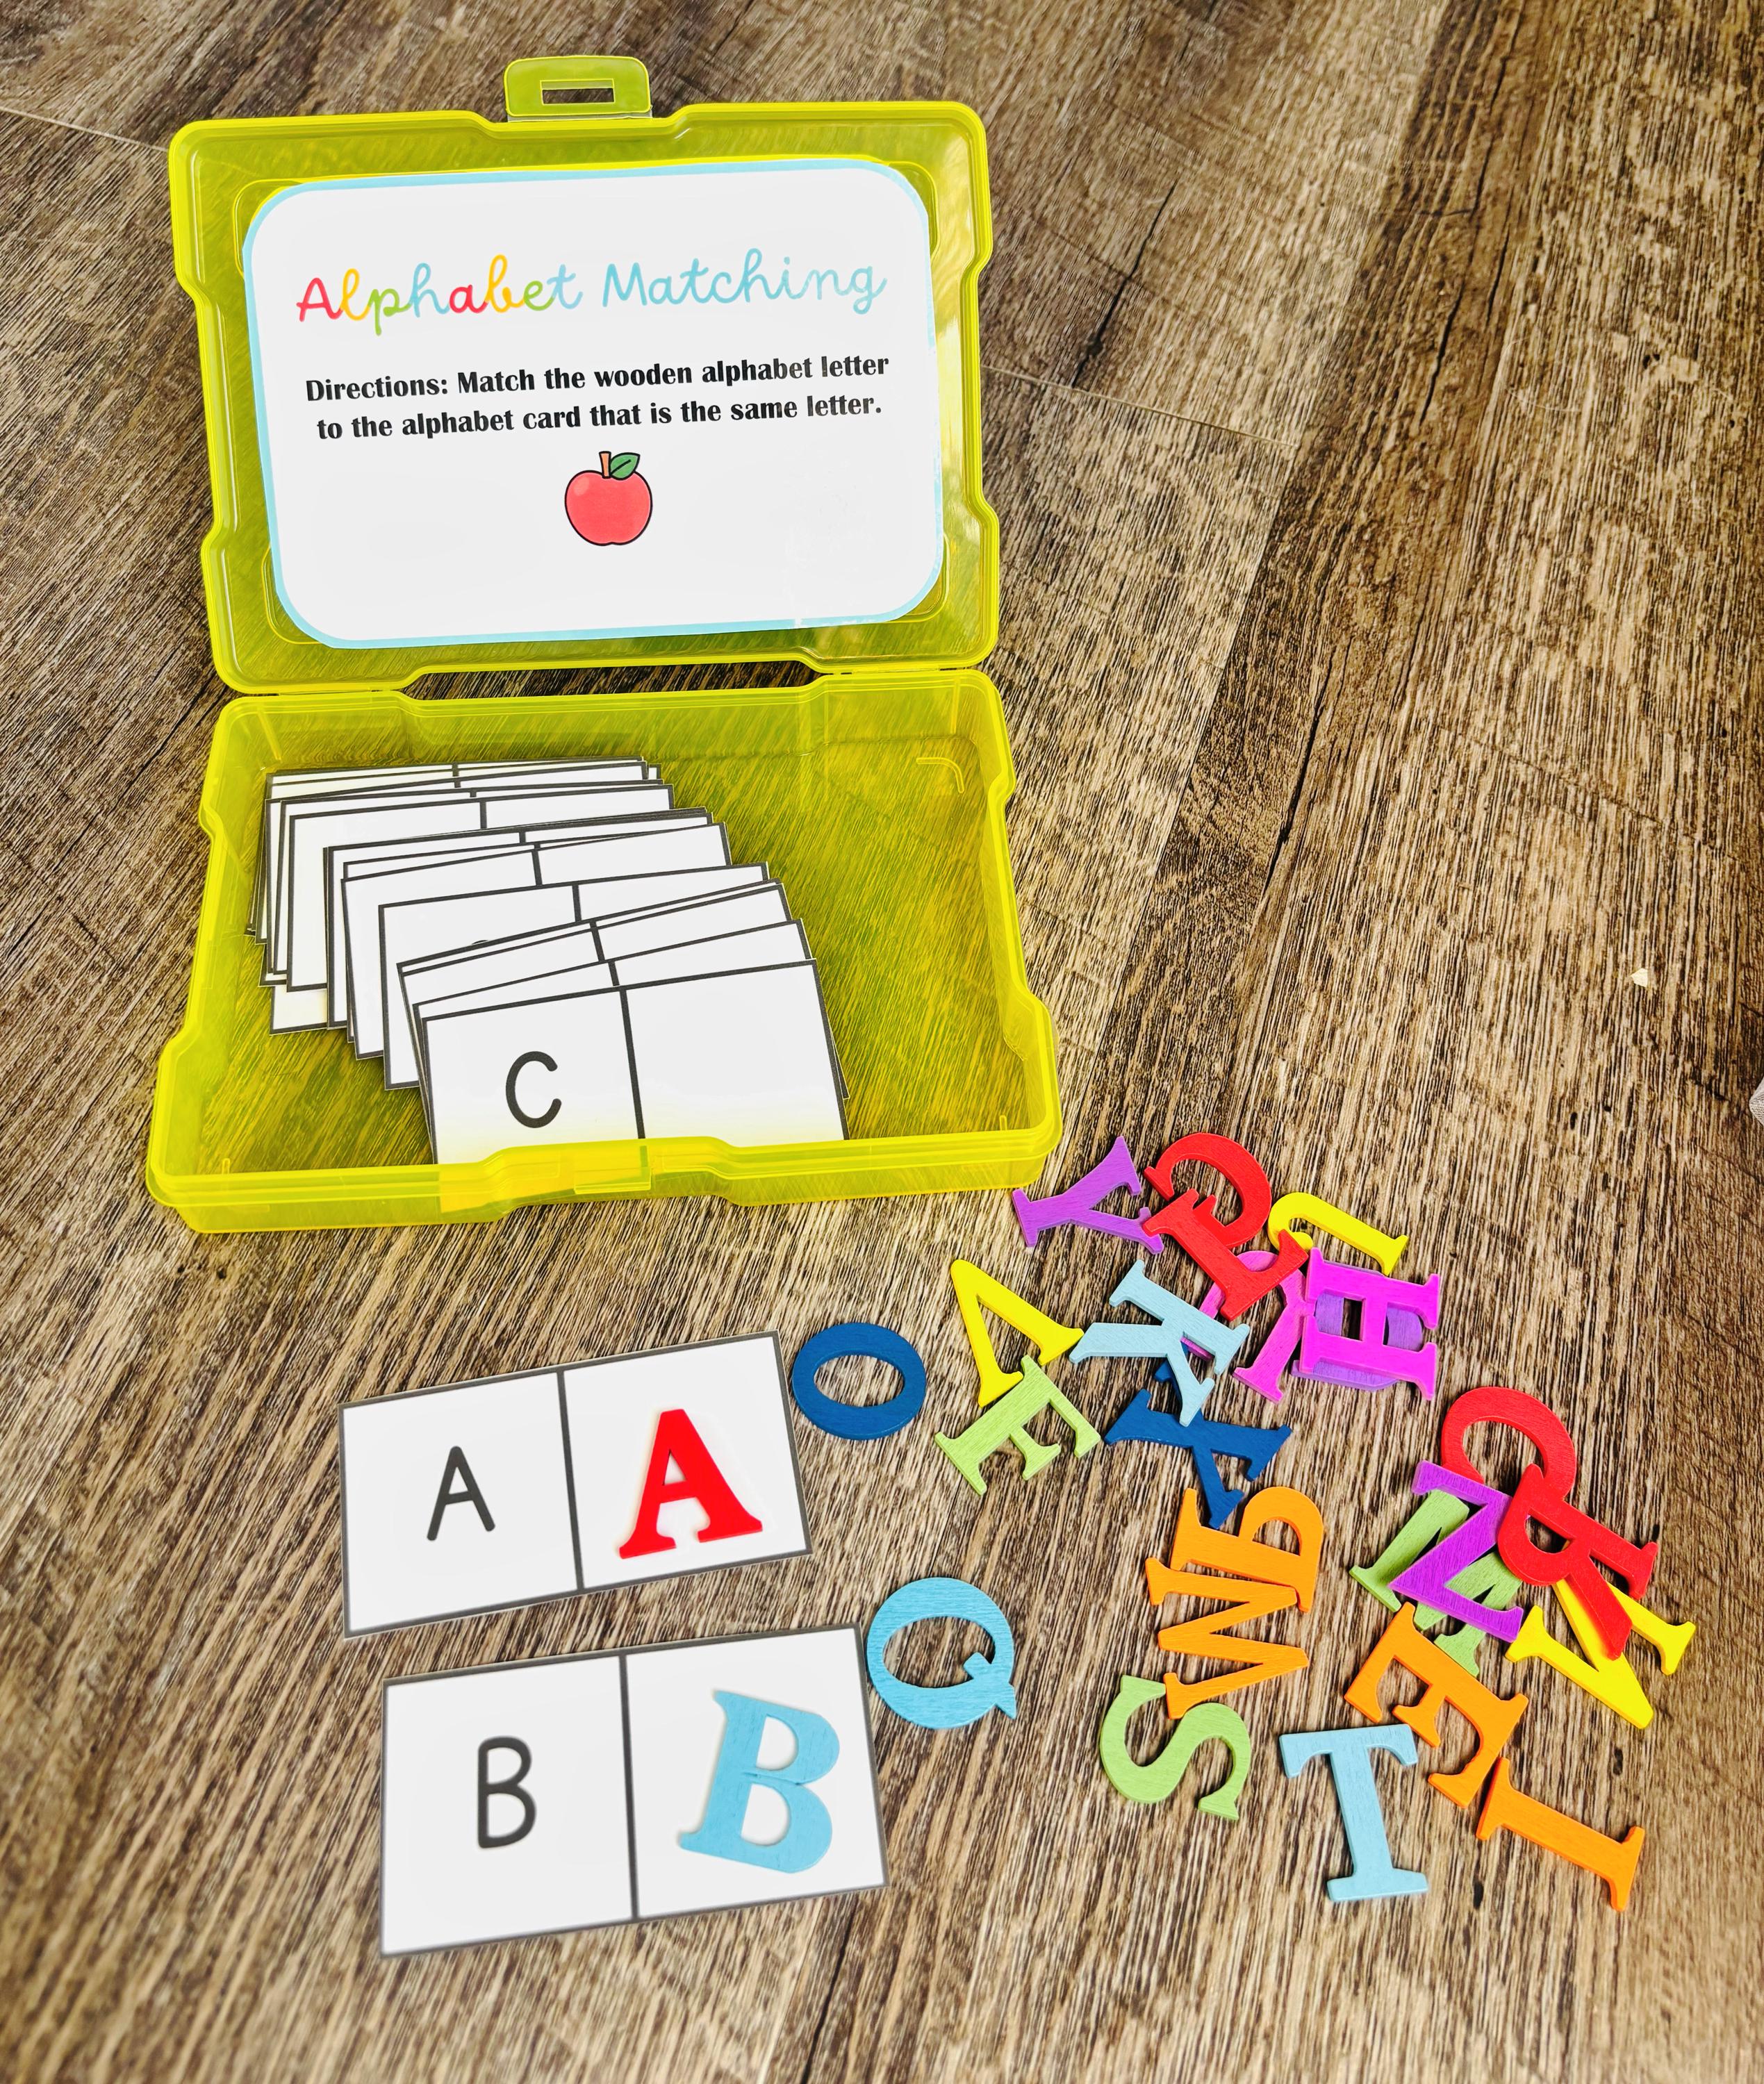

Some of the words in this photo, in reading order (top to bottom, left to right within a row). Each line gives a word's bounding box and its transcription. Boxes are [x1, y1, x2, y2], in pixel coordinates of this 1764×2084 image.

[297, 253, 583, 336] Alphabet
[602, 248, 887, 315] Matching
[305, 373, 449, 402] Directions:
[456, 368, 535, 394] Match
[544, 367, 586, 390] the
[593, 362, 692, 388] wooden
[702, 357, 813, 387] alphabet
[821, 354, 889, 378] letter
[316, 419, 343, 440] to
[351, 415, 393, 438] the
[402, 409, 514, 440] alphabet
[522, 405, 581, 430] card
[589, 404, 642, 427] that
[650, 402, 672, 424] is
[680, 399, 721, 423] the
[730, 400, 798, 421] same
[807, 394, 882, 417] letter.
[505, 1050, 563, 1130] C
[1012, 1136, 1164, 1254] Y
[1142, 1187, 1309, 1321] L
[791, 1322, 928, 1441] O
[1069, 1259, 1251, 1428] K
[1299, 1247, 1440, 1402] H
[427, 1446, 495, 1542] A
[618, 1409, 763, 1560] A
[935, 1355, 1102, 1496] F
[1170, 1485, 1324, 1613] P
[1388, 1459, 1524, 1644] Z
[1497, 1462, 1659, 1661] R
[866, 1576, 1018, 1732] Q
[1343, 1601, 1529, 1809] E
[478, 1736, 537, 1850] B
[678, 1689, 841, 1875] B
[1099, 1674, 1251, 1821] S
[1279, 1723, 1429, 1903] T
[1475, 1755, 1646, 1912] I
